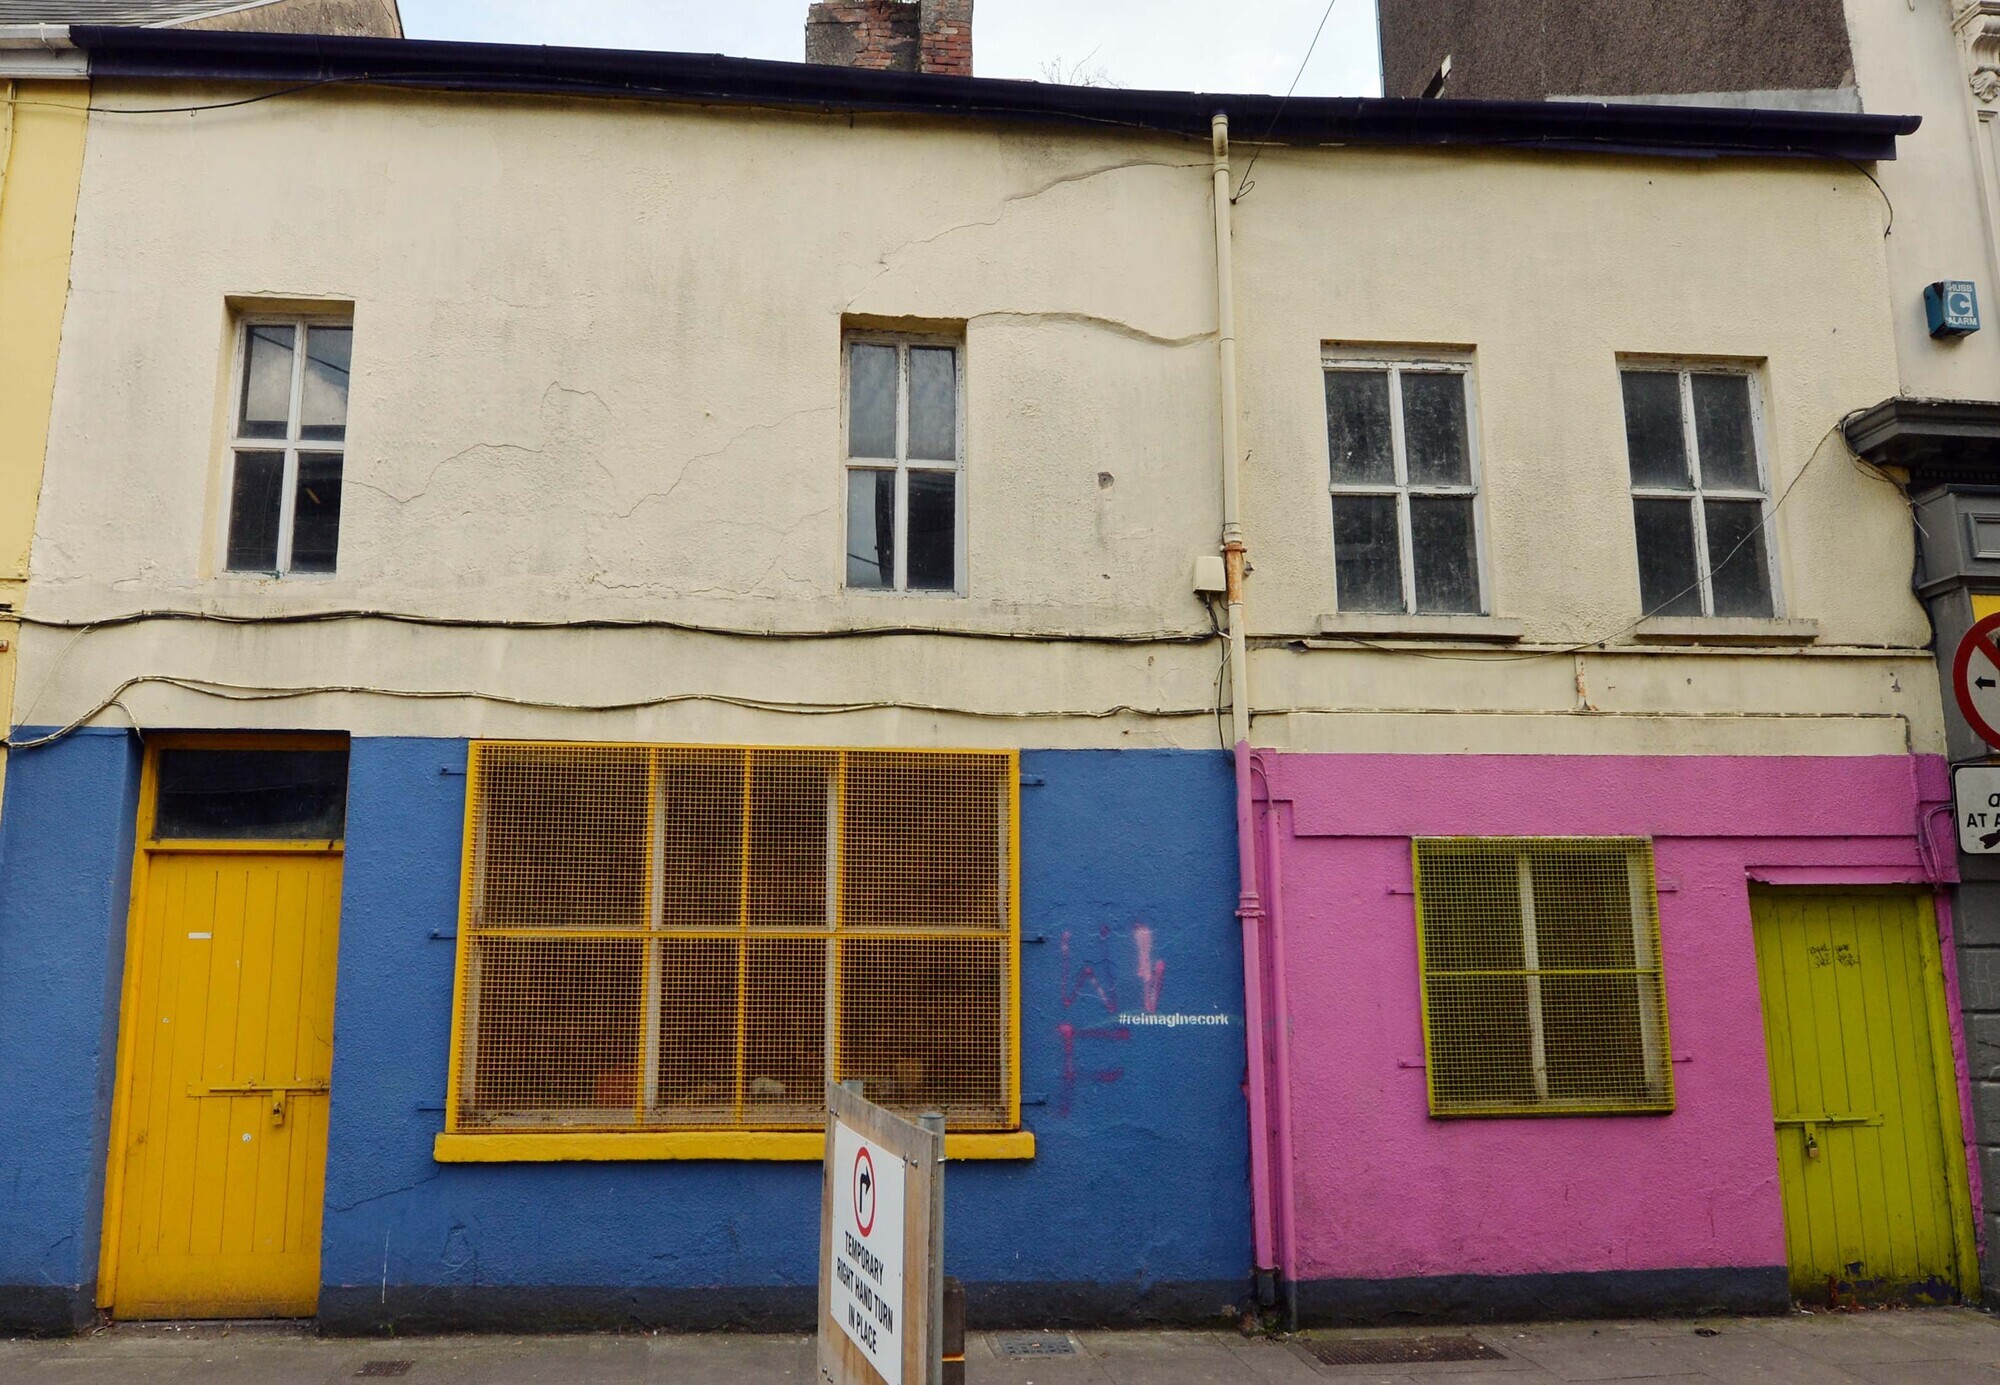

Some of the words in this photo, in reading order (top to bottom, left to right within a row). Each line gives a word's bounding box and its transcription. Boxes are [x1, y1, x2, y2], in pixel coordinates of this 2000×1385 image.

[1945, 283, 1973, 292] CHUBB
[1947, 317, 1977, 326] ALARM
[1967, 813, 1987, 828] AT
[1118, 1012, 1229, 1028] #reimaginecork
[845, 1230, 884, 1286] TEMPORARY
[836, 1256, 854, 1293] RIGHT
[855, 1274, 873, 1312] HAND
[874, 1293, 893, 1335] TURN
[848, 1302, 855, 1330] IN
[856, 1311, 877, 1355] PLACE
